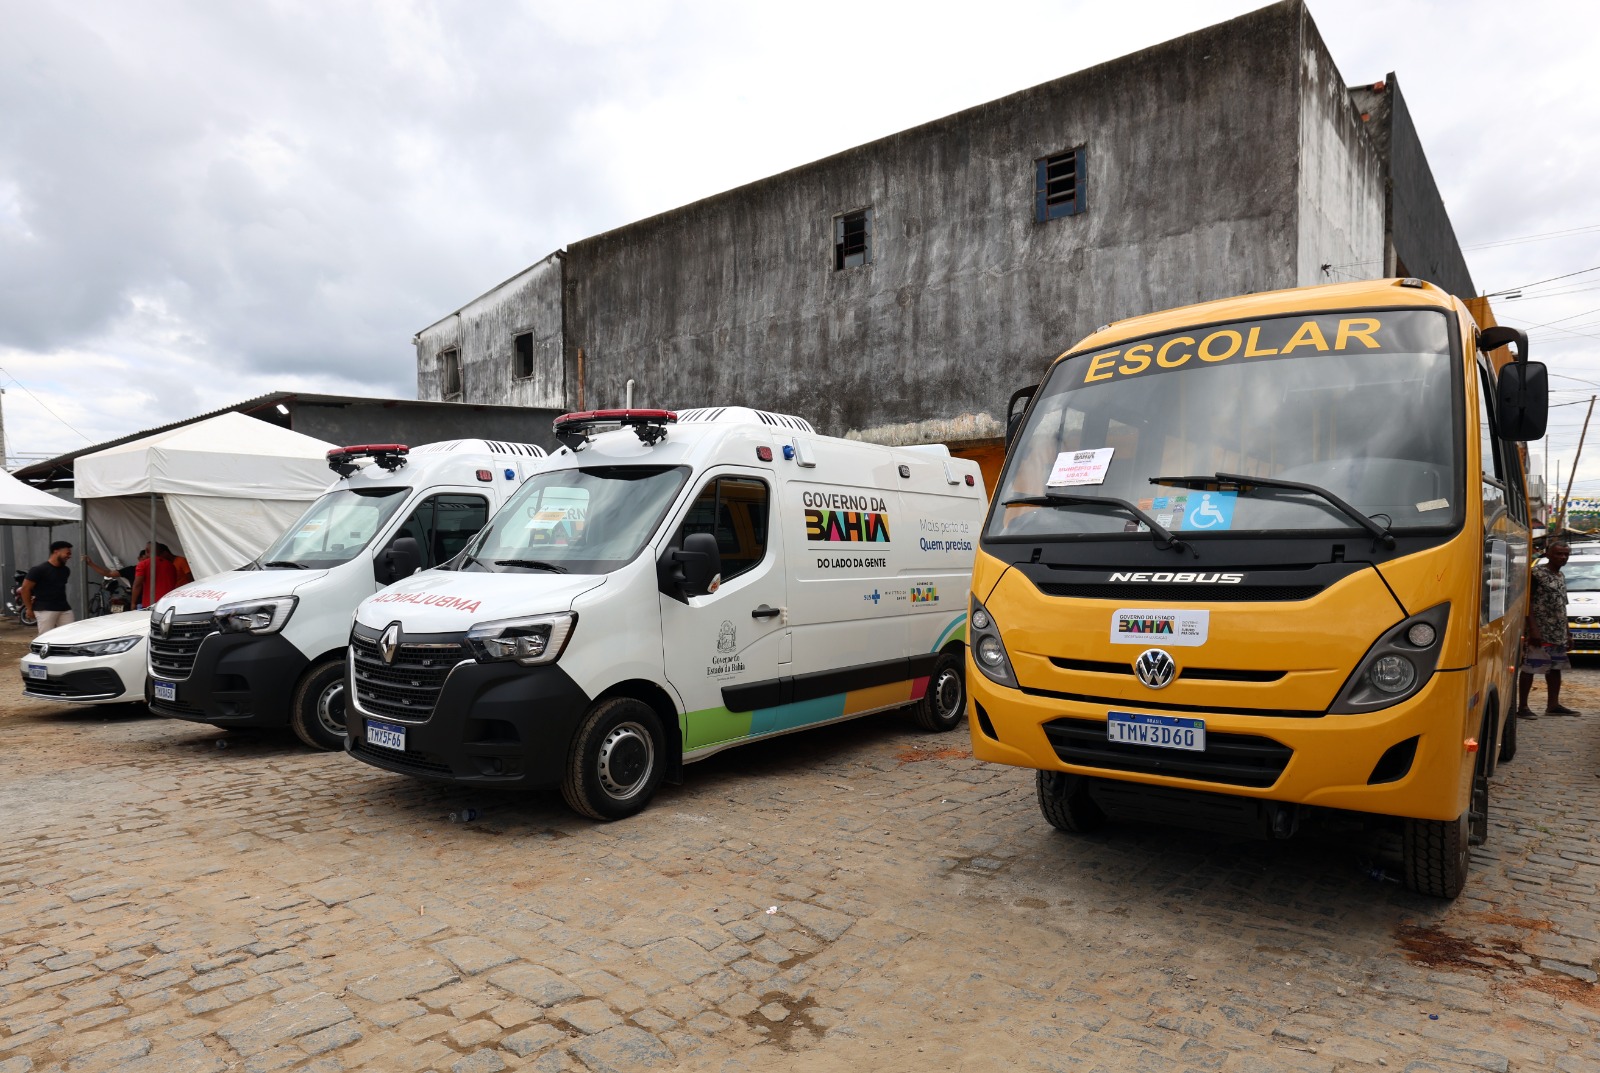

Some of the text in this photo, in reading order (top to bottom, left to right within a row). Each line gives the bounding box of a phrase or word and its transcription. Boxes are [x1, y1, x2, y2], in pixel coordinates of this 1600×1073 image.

[1083, 317, 1381, 383] ESCOLAR
[803, 491, 887, 512] GOVERNO DA
[804, 509, 891, 542] BAHIA
[920, 519, 939, 531] Mais
[920, 537, 972, 553] Quem precisa
[817, 558, 886, 568] DO LADO DA GENTE
[1109, 572, 1244, 584] NEOBUS
[1118, 619, 1174, 634] BAHIA
[731, 662, 746, 671] Bahia
[1117, 723, 1194, 747] TMW3D60
